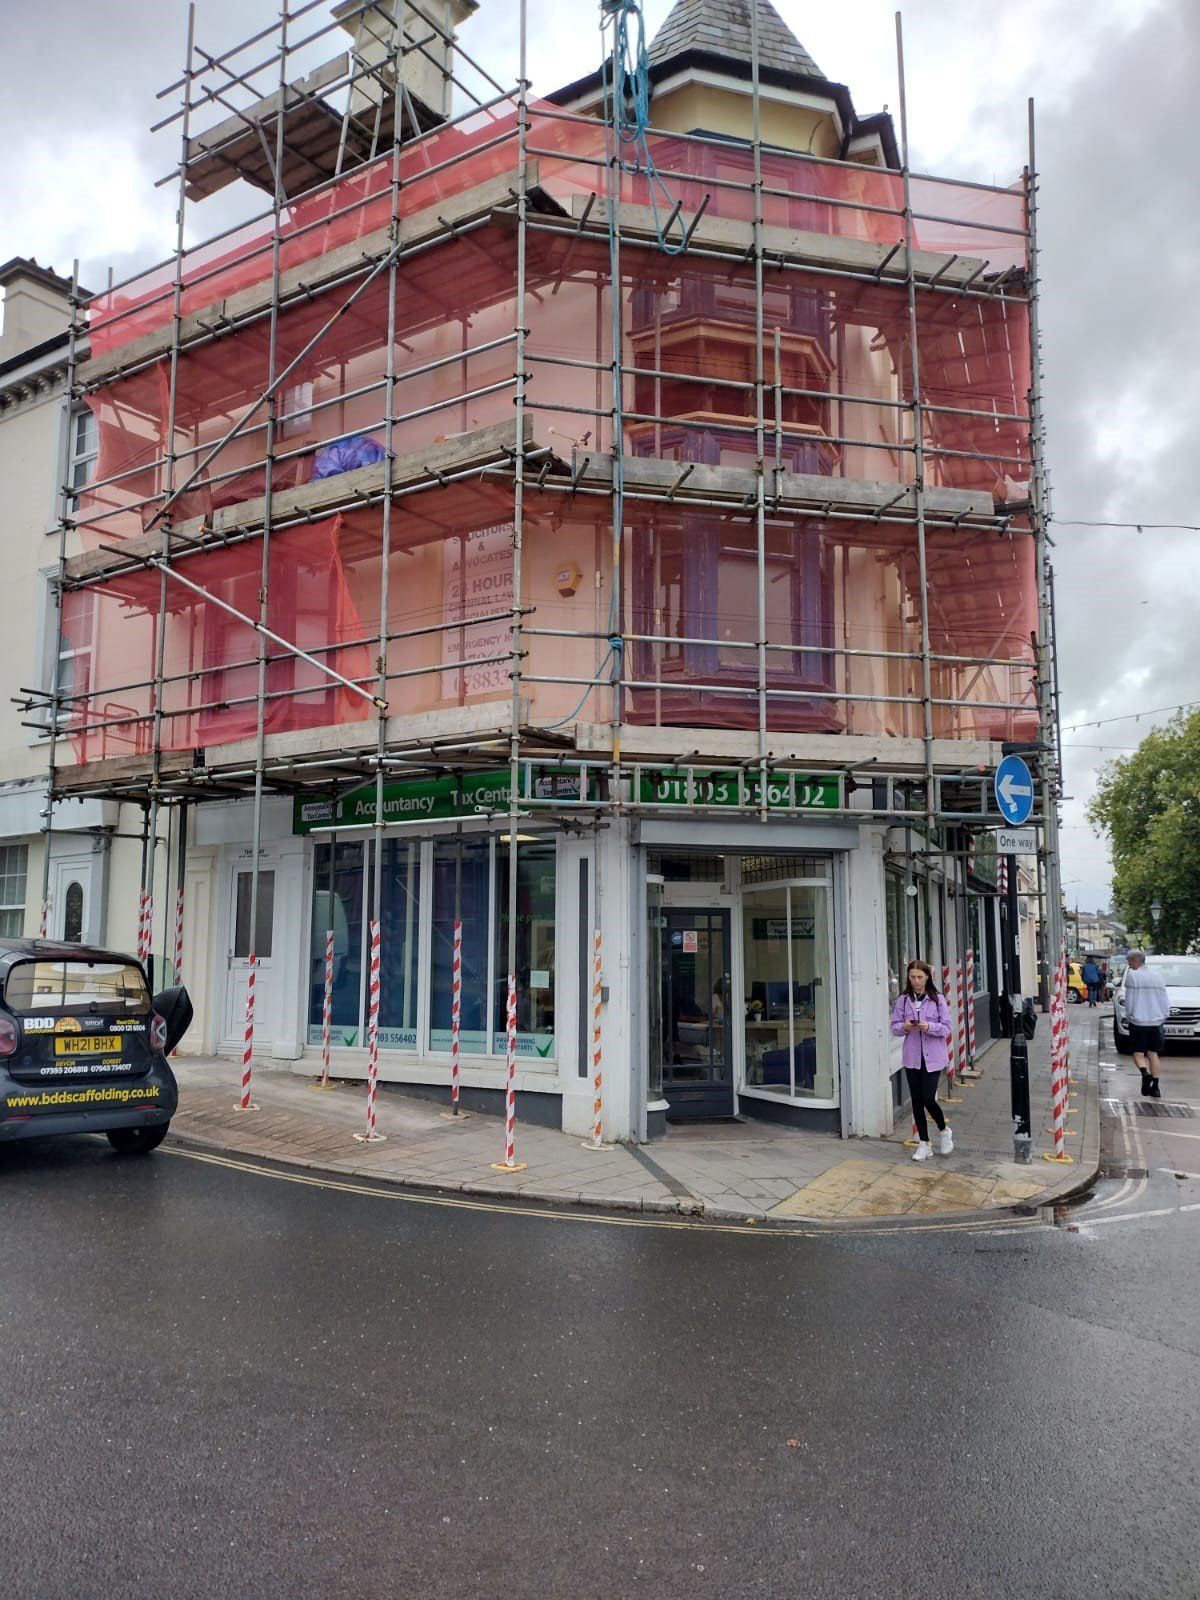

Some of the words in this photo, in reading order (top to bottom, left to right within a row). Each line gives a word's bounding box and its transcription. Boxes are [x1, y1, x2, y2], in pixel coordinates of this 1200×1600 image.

[478, 541, 485, 551] &
[452, 549, 513, 572] AVOCATES
[355, 796, 435, 816] Accuntancy
[1000, 835, 1016, 847] One
[1018, 839, 1033, 850] way
[24, 1017, 55, 1029] BDD
[64, 1039, 91, 1052] WH21
[93, 1038, 115, 1051] BHX
[390, 1033, 417, 1043] 556402
[7, 1085, 160, 1107] www.bddscaffolding.co.uk
